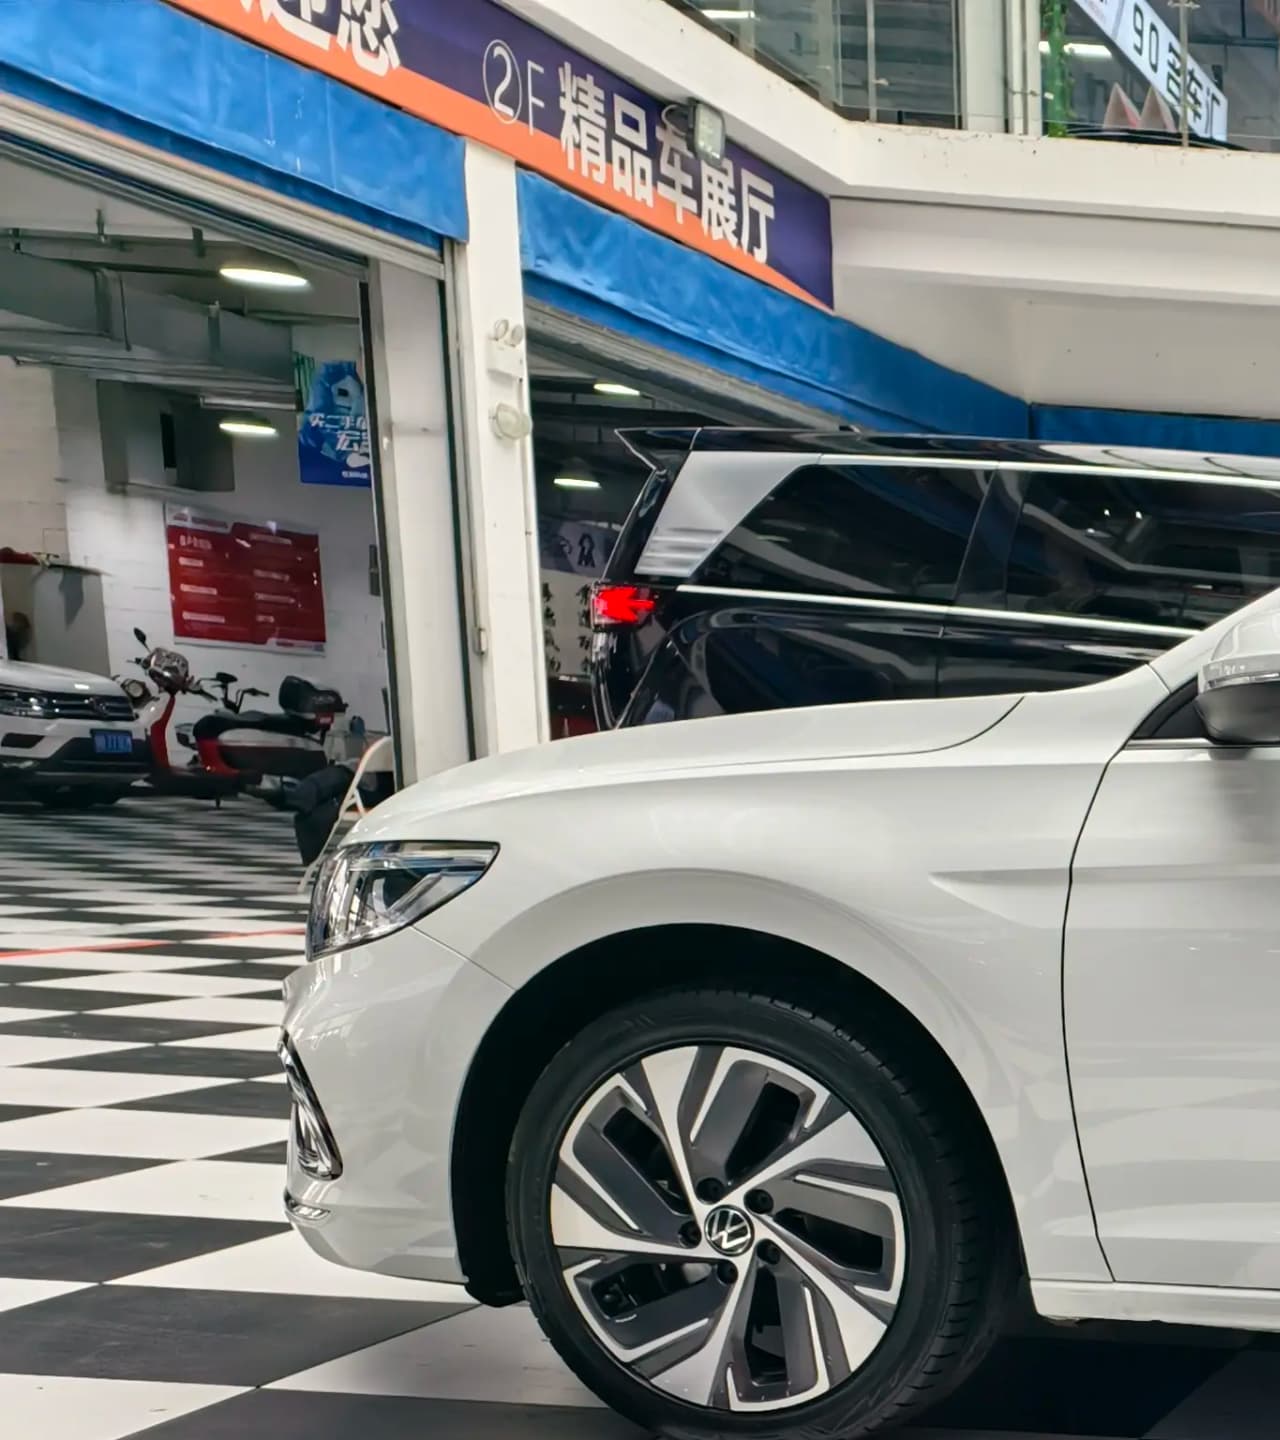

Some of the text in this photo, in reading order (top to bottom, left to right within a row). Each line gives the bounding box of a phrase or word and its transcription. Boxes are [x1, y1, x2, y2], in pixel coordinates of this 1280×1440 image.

[558, 61, 776, 265] 精品车展厅
